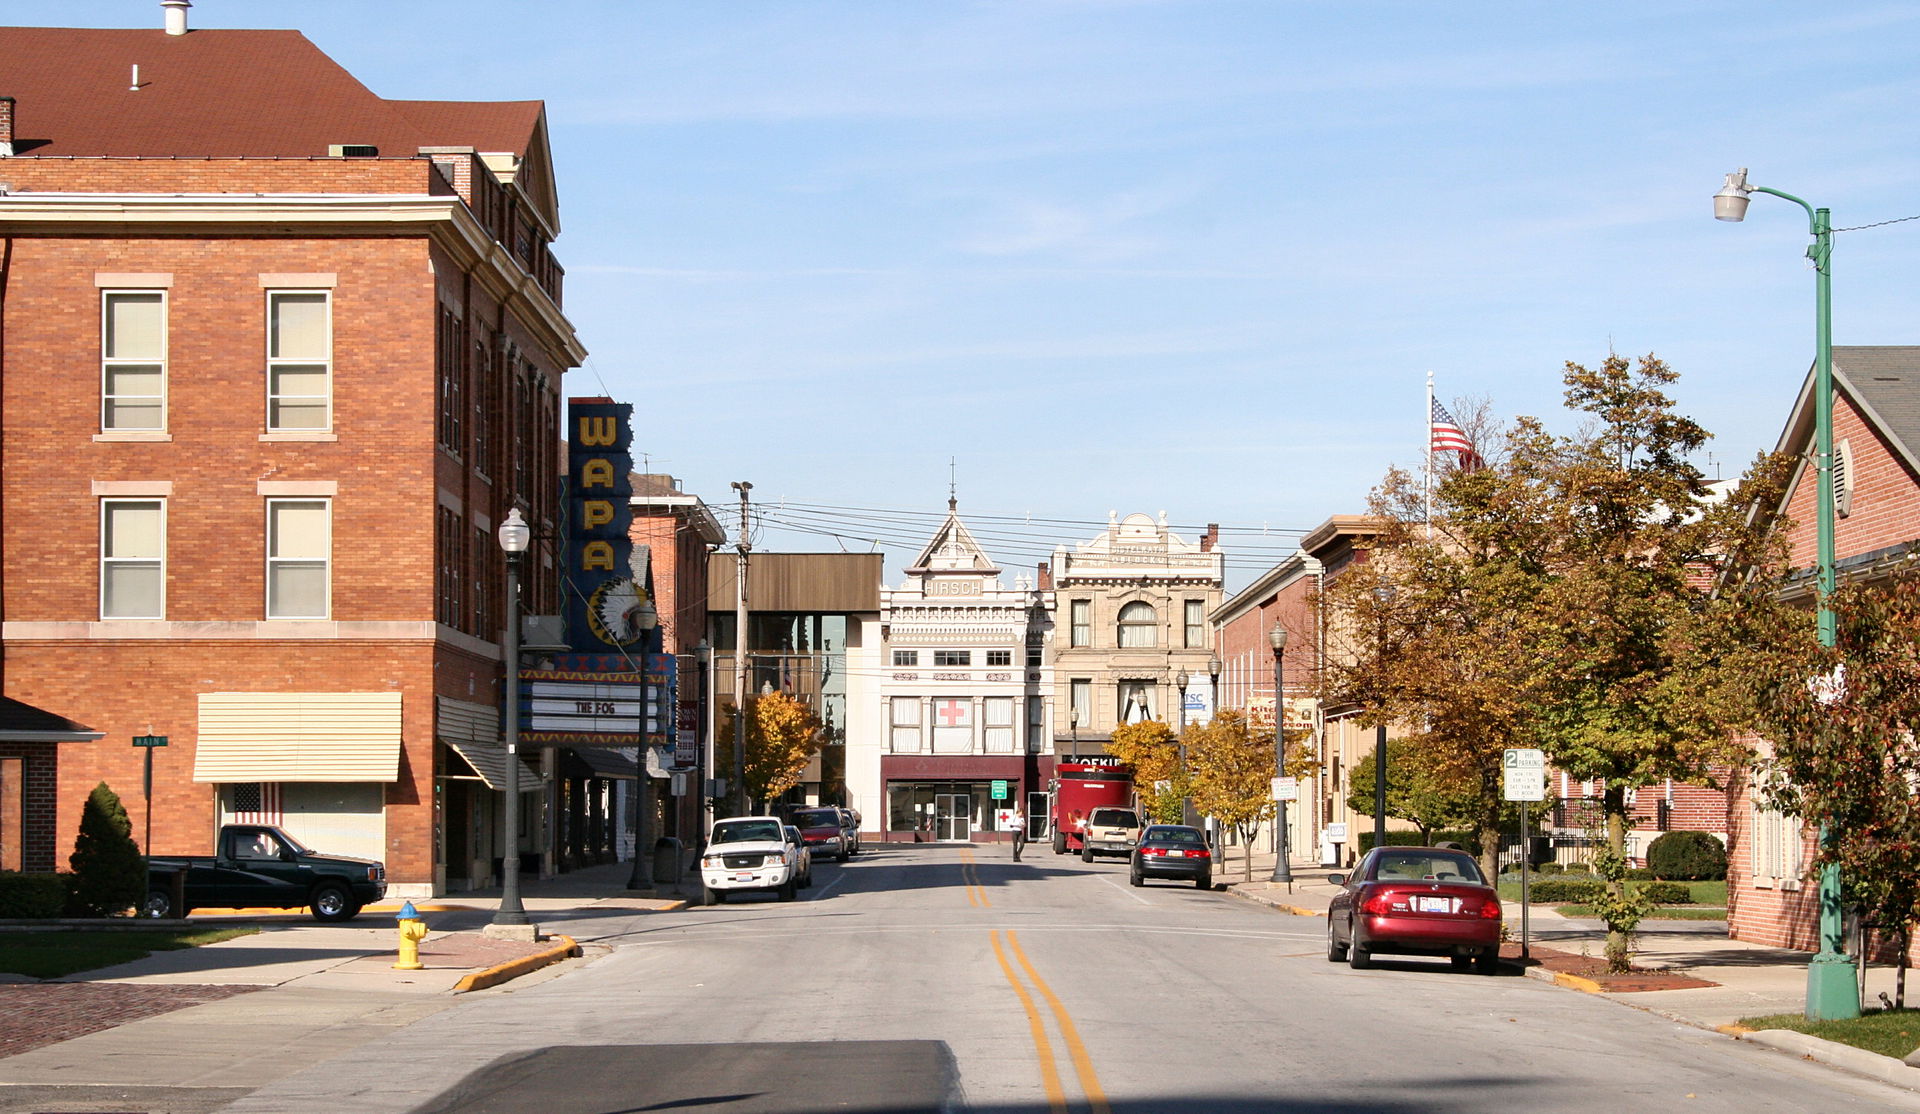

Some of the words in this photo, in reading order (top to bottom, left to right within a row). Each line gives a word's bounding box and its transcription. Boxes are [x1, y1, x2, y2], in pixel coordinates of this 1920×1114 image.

[579, 416, 617, 571] WAPA
[924, 581, 981, 595] HIRSCH
[575, 701, 592, 714] THE
[595, 702, 616, 714] FOG
[135, 737, 160, 746] MAIN
[1506, 752, 1517, 766] 2
